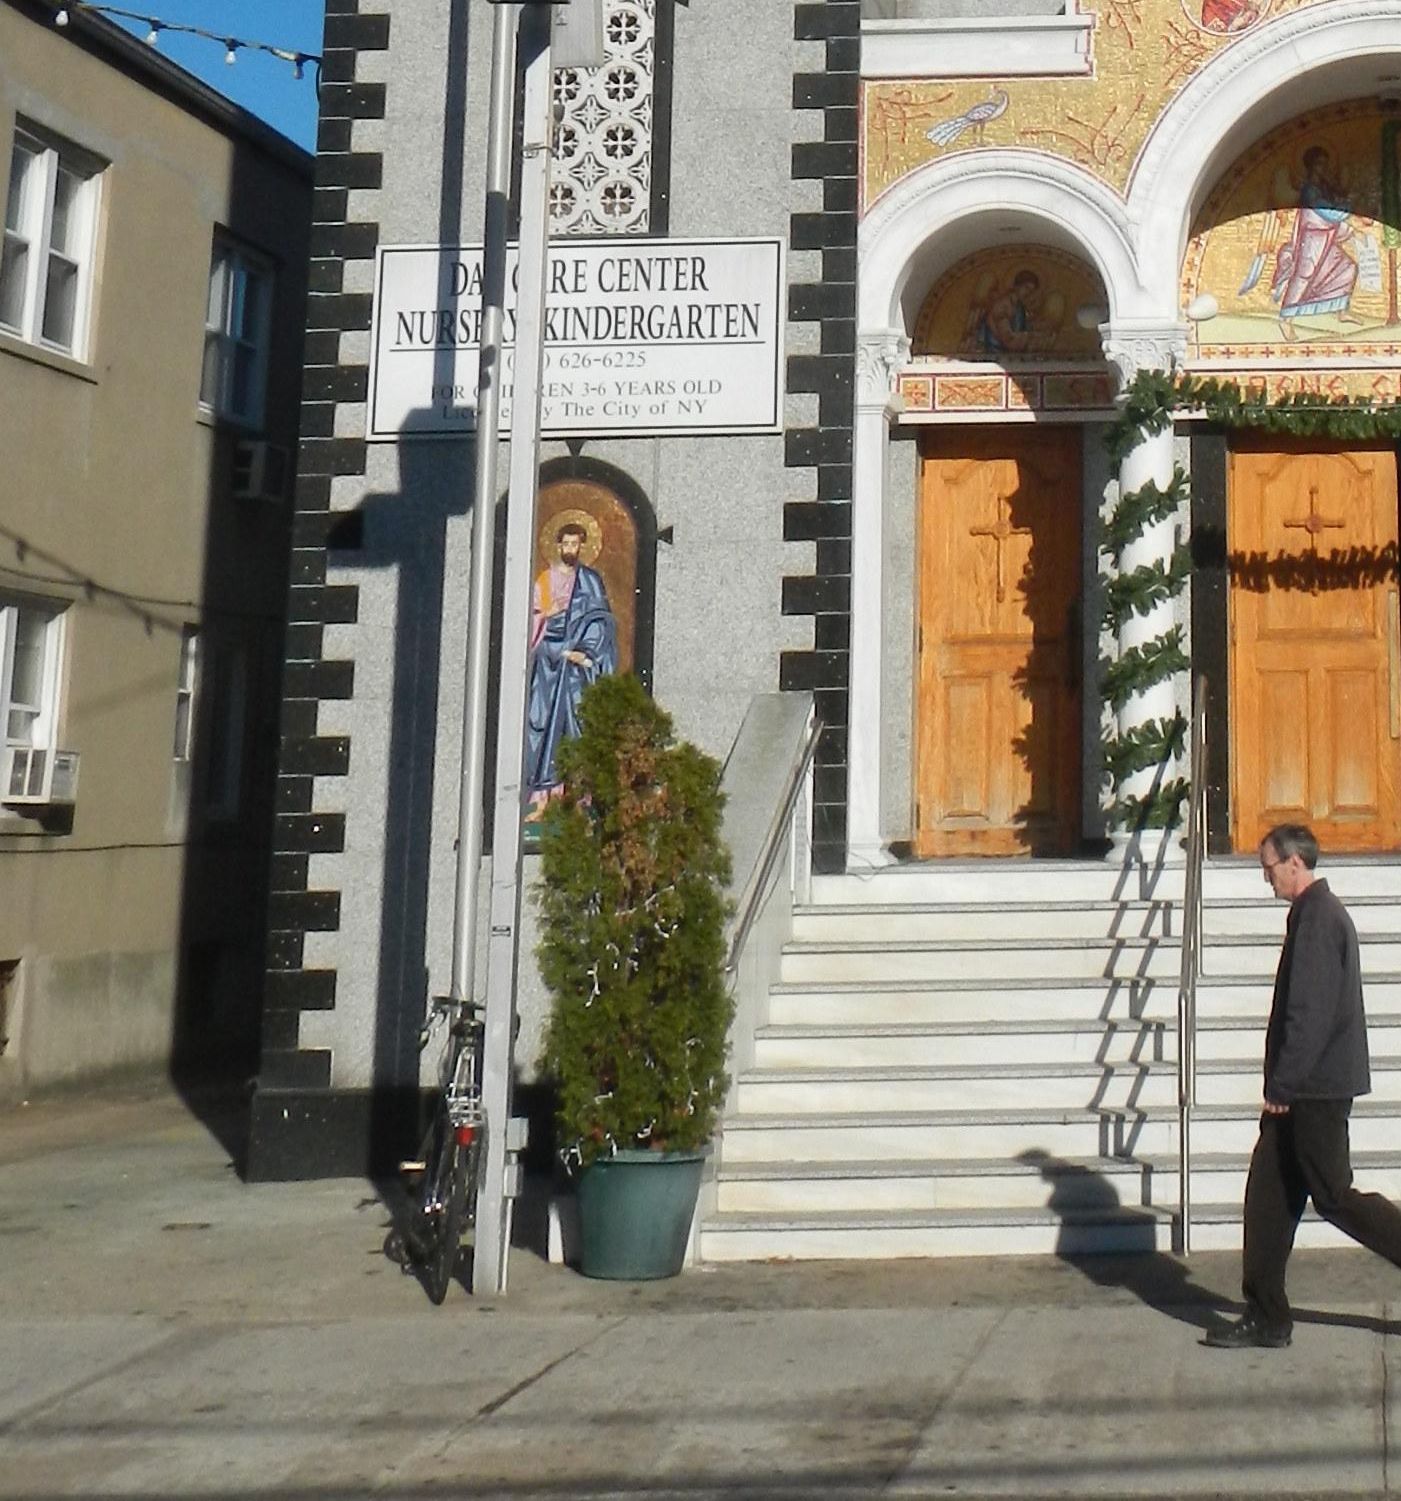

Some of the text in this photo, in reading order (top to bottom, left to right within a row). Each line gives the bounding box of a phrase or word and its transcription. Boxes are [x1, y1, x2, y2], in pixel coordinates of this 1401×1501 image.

[450, 262, 484, 296] DA
[597, 256, 710, 293] CENTER
[395, 303, 761, 345] NURSEY KINDERGARTEN
[559, 351, 647, 369] 626-6225
[581, 382, 607, 397] 3-6
[615, 380, 676, 396] YEARS
[683, 379, 722, 395] OLD
[562, 401, 595, 416] The
[603, 400, 641, 418] City
[650, 400, 670, 414] of
[678, 399, 707, 414] NY
